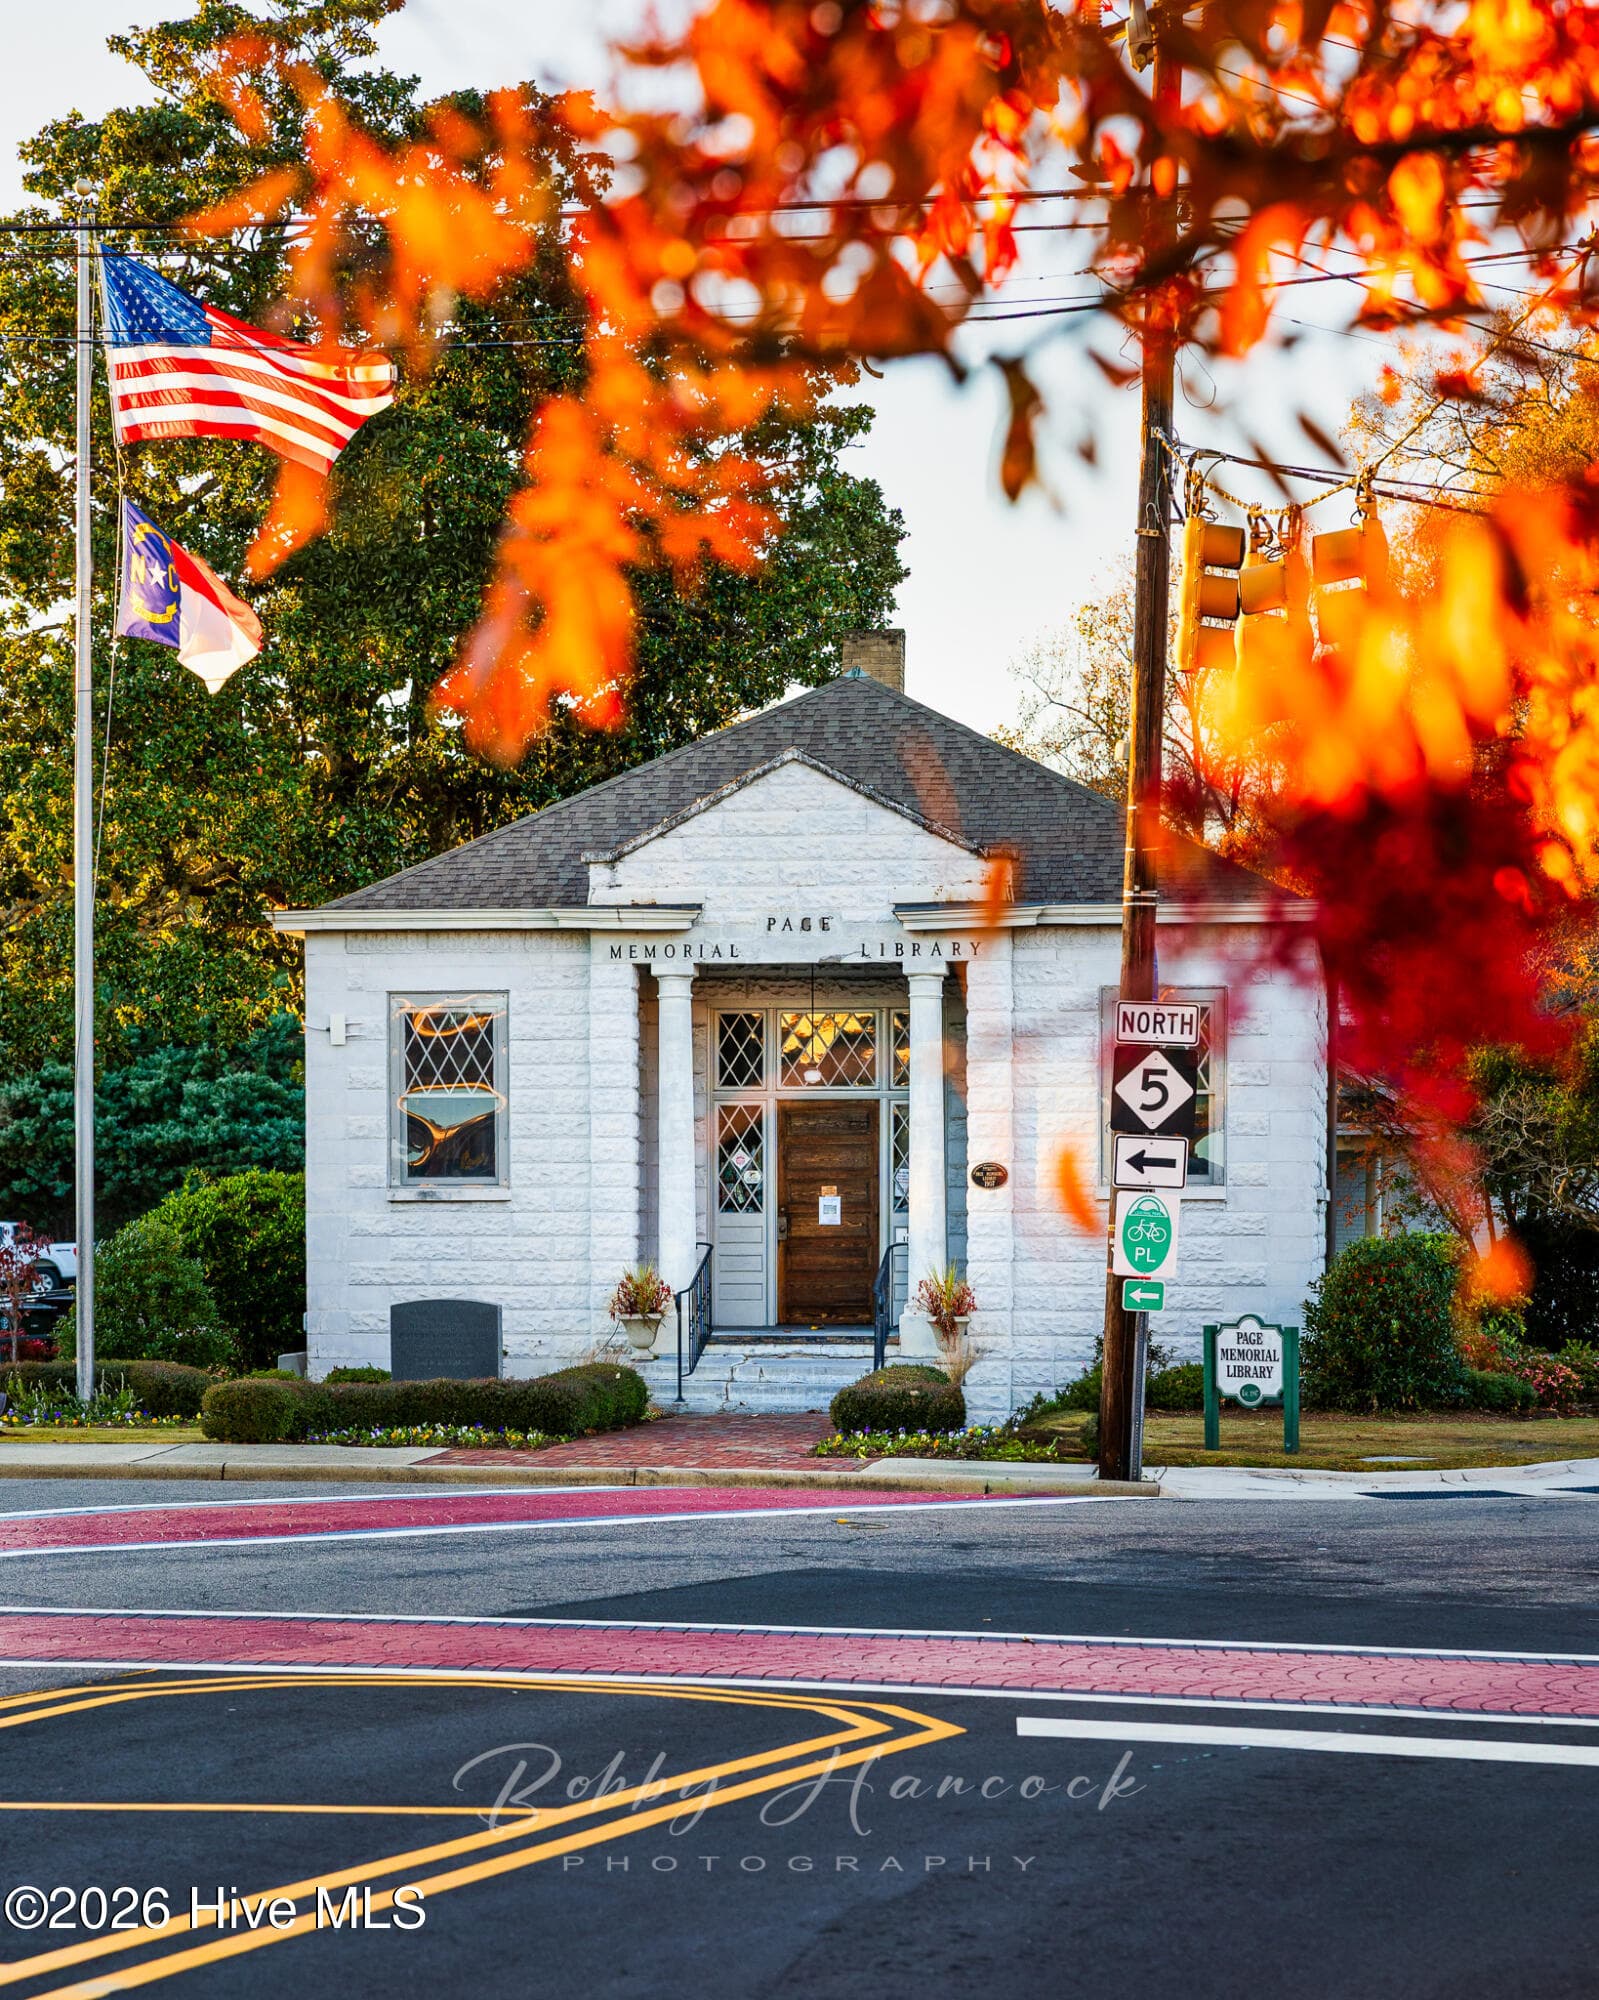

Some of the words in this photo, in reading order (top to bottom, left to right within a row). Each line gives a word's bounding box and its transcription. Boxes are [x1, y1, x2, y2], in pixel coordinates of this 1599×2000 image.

[130, 552, 146, 585] N
[168, 563, 178, 592] C
[767, 916, 833, 932] PAGE
[609, 943, 739, 960] MEMORIAL
[860, 941, 982, 958] LIBRARY
[1121, 1011, 1194, 1036] NORTH
[1139, 1068, 1169, 1112] 5
[1134, 1247, 1157, 1264] PL
[1236, 1331, 1263, 1345] PAGE
[1220, 1348, 1280, 1363] MEMORIAL
[1226, 1364, 1274, 1379] LIBRARY
